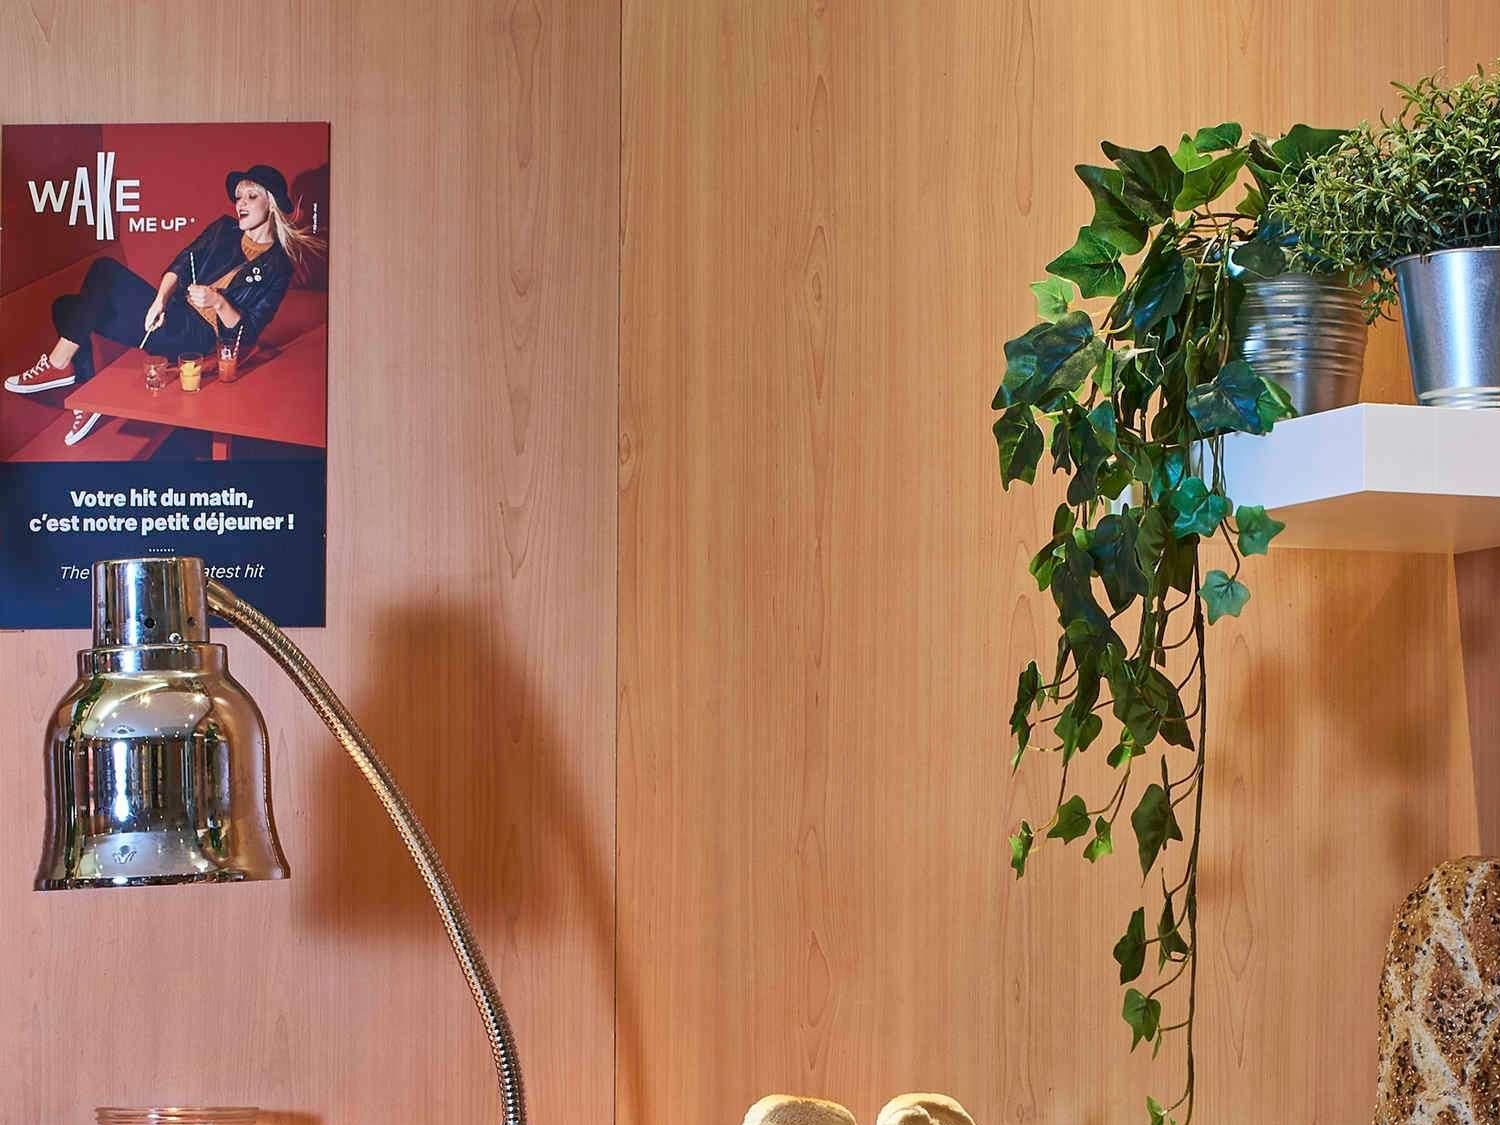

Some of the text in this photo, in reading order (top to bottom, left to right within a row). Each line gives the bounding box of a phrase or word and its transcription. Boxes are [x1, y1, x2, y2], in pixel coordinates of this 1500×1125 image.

[28, 151, 140, 240] WAKE
[129, 217, 157, 232] ME
[70, 488, 254, 509] Votre hit du matin,
[29, 513, 80, 532] c'est
[83, 515, 138, 532] notre
[141, 512, 190, 536] petit
[193, 512, 283, 536] déjeuner
[60, 566, 90, 580] The
[244, 563, 265, 579] hit
